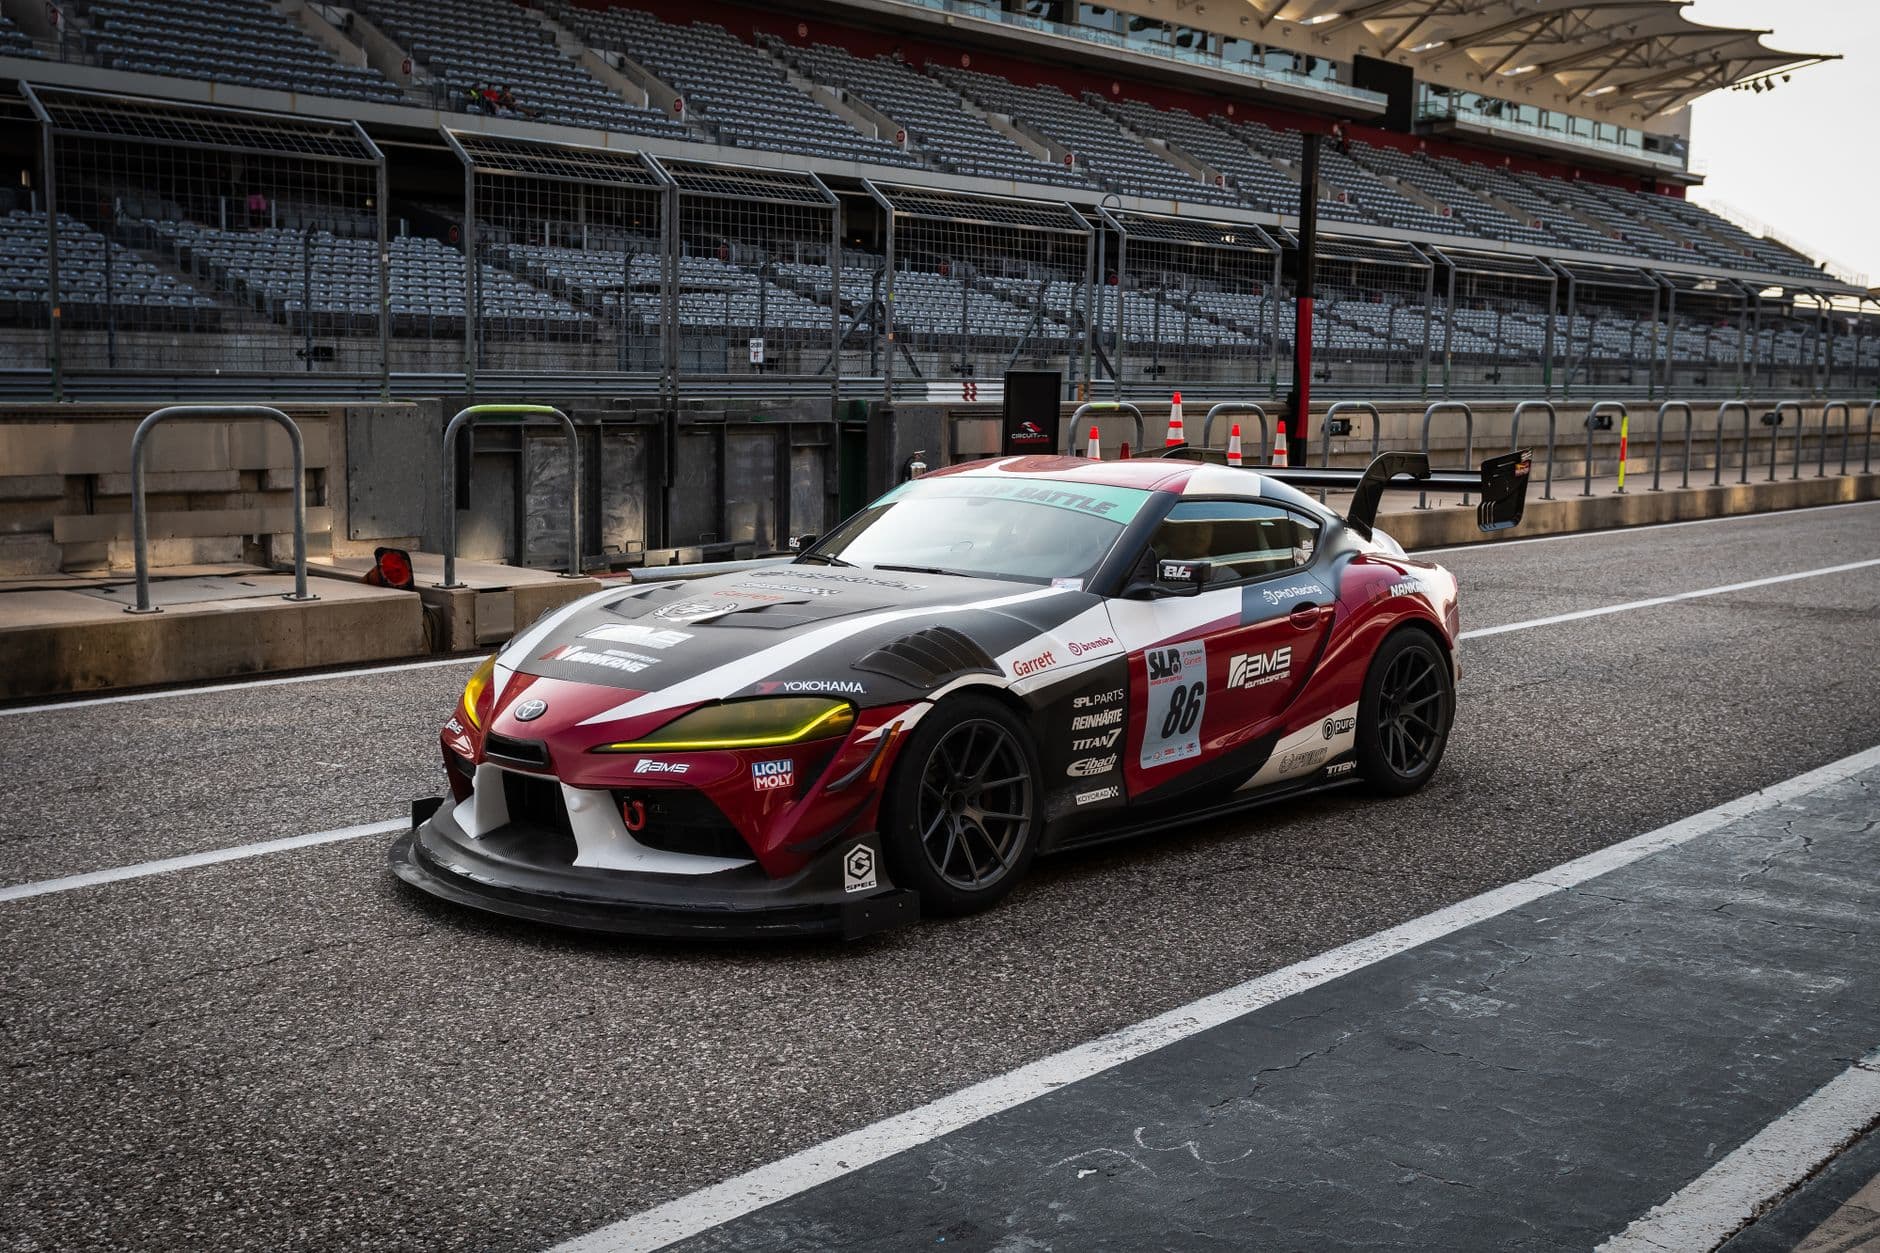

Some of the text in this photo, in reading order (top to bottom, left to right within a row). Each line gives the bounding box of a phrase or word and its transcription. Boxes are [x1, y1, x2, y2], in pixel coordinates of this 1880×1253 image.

[1014, 487, 1119, 515] BATTLE
[1080, 636, 1115, 652] brembo
[1012, 651, 1057, 677] Garrett
[783, 681, 864, 694] YOKOHAMA
[1073, 688, 1125, 709] SPL PARTS
[1071, 708, 1123, 731] REINHÄRTE
[1161, 681, 1205, 739] 86
[1335, 718, 1355, 733] pure
[753, 760, 792, 777] LIQUI
[755, 774, 793, 790] MOLY
